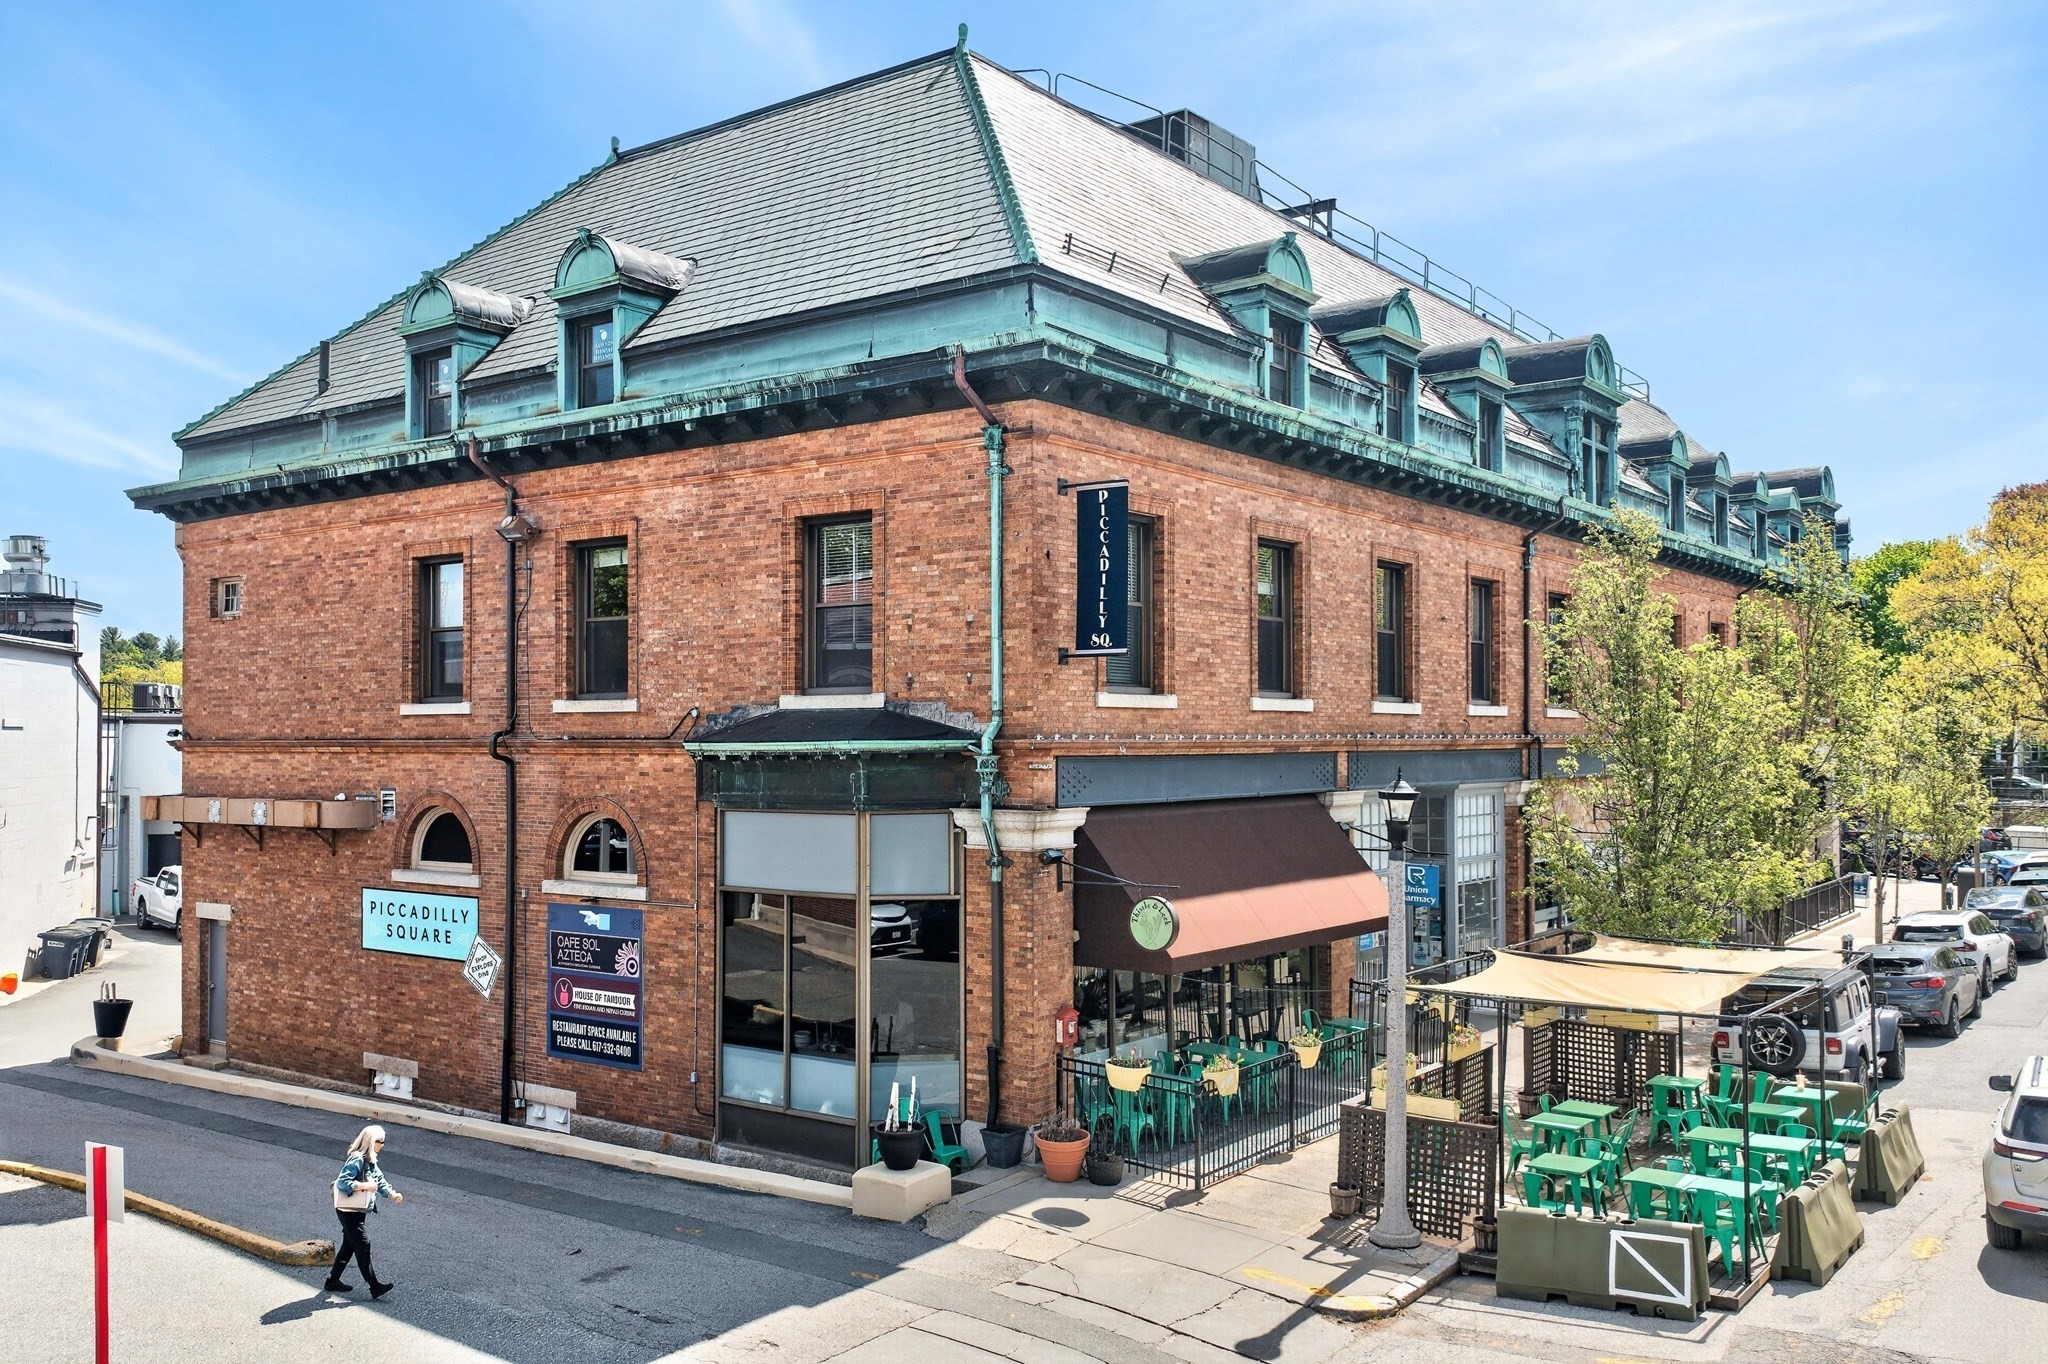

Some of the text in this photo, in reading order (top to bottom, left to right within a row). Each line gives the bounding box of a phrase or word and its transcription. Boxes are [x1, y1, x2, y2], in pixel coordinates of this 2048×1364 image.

[1098, 489, 1110, 628] PICCADILLY
[1090, 633, 1113, 648] SQ.
[1405, 895, 1436, 905] armacy
[370, 900, 469, 924] PICCADILLY
[386, 923, 452, 944] SQUARE
[557, 935, 601, 951] CAFE SOL
[557, 948, 593, 963] AZTECA
[574, 990, 593, 1001] HOUSE
[594, 993, 602, 1002] OF
[552, 1020, 637, 1043] RESTAURANT SPACE AVAILABLE
[556, 1035, 577, 1049] PLEASE
[577, 1038, 592, 1051] CALL
